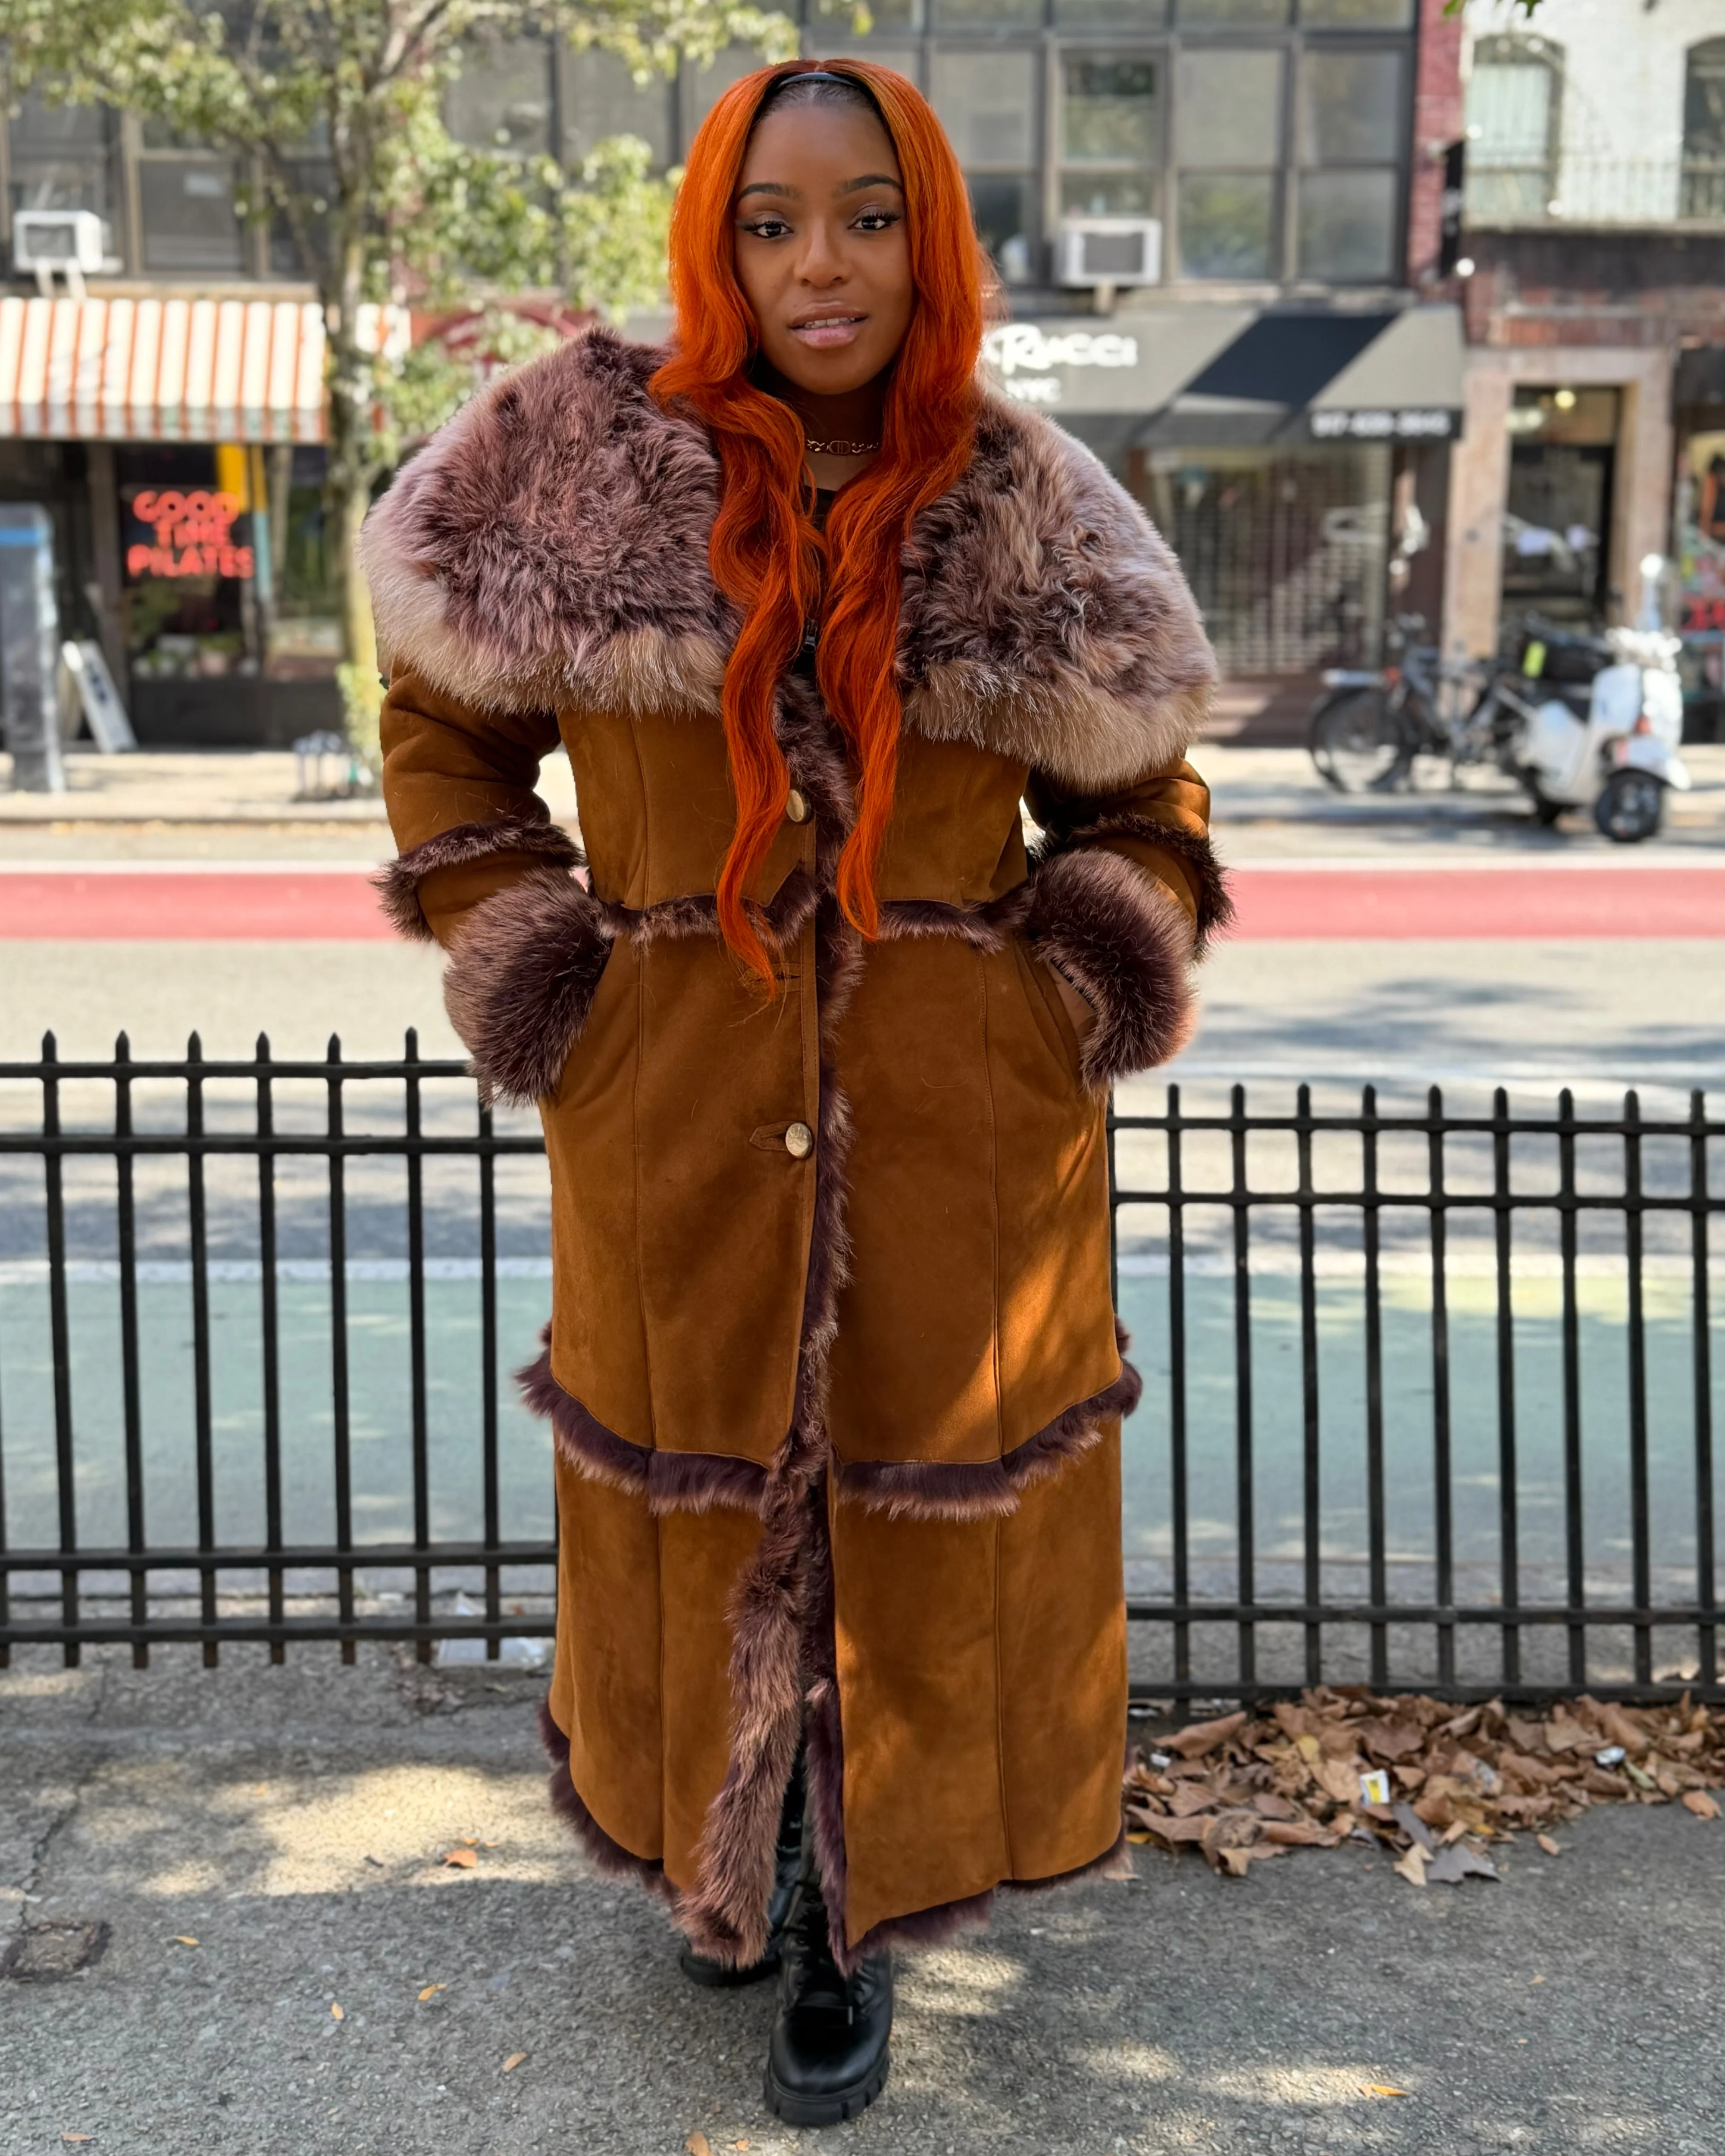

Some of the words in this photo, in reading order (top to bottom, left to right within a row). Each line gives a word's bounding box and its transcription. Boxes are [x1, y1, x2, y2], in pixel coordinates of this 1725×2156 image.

[133, 490, 240, 523] GOOD
[153, 519, 232, 547] TIME
[127, 544, 254, 579] PILATES
